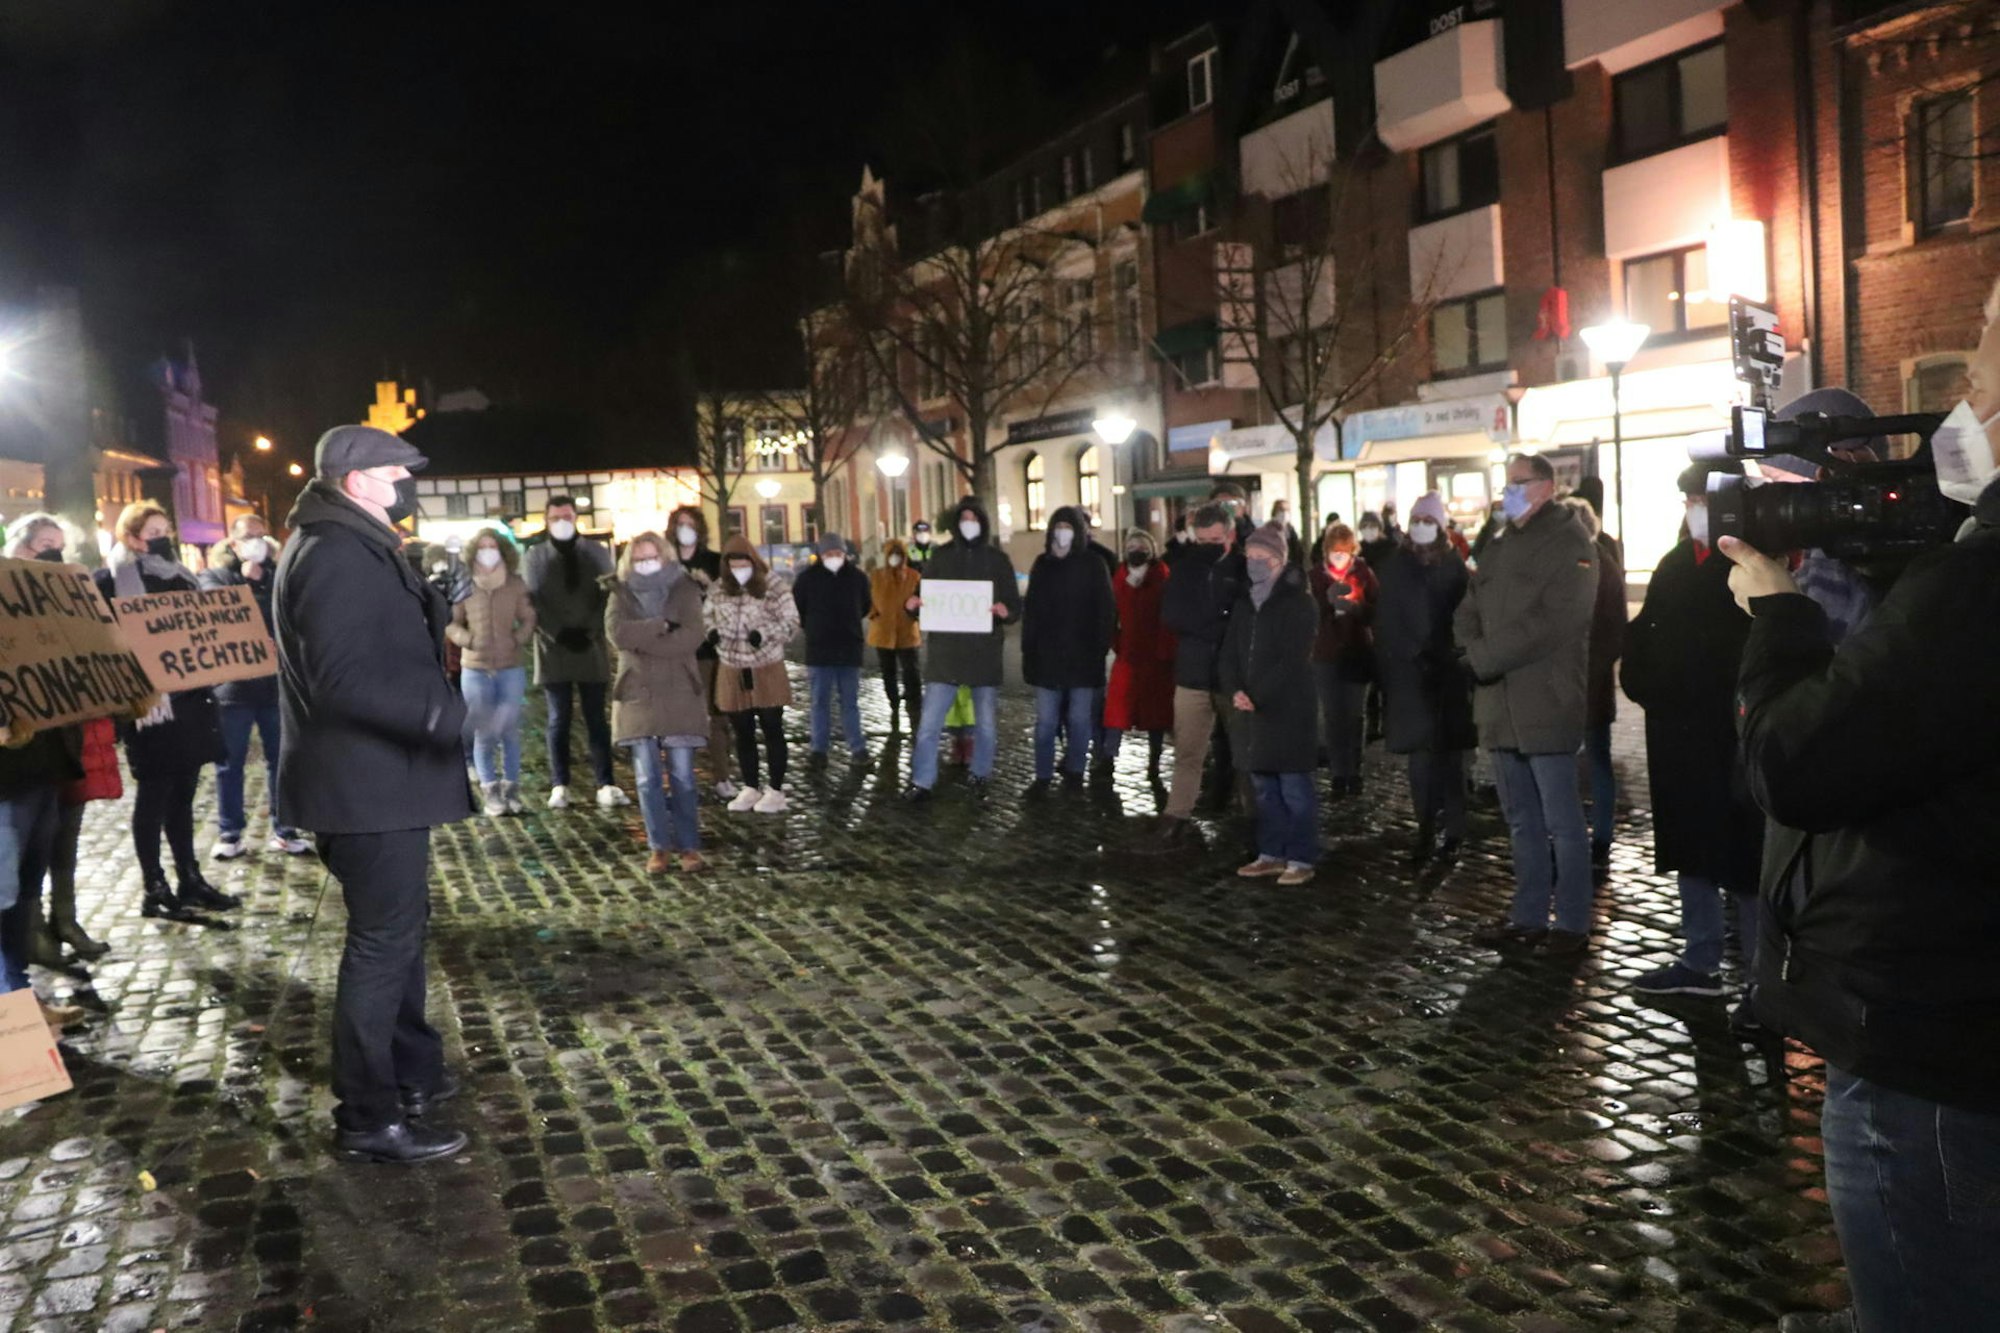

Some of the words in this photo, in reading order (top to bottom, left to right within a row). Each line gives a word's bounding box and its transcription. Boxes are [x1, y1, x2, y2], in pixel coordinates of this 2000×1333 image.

[120, 590, 241, 615] DEMOKRATEN
[145, 611, 207, 634] LAUFEN
[210, 606, 253, 626] NICHT
[190, 629, 219, 646] MIT
[159, 640, 269, 680] RECHTEN
